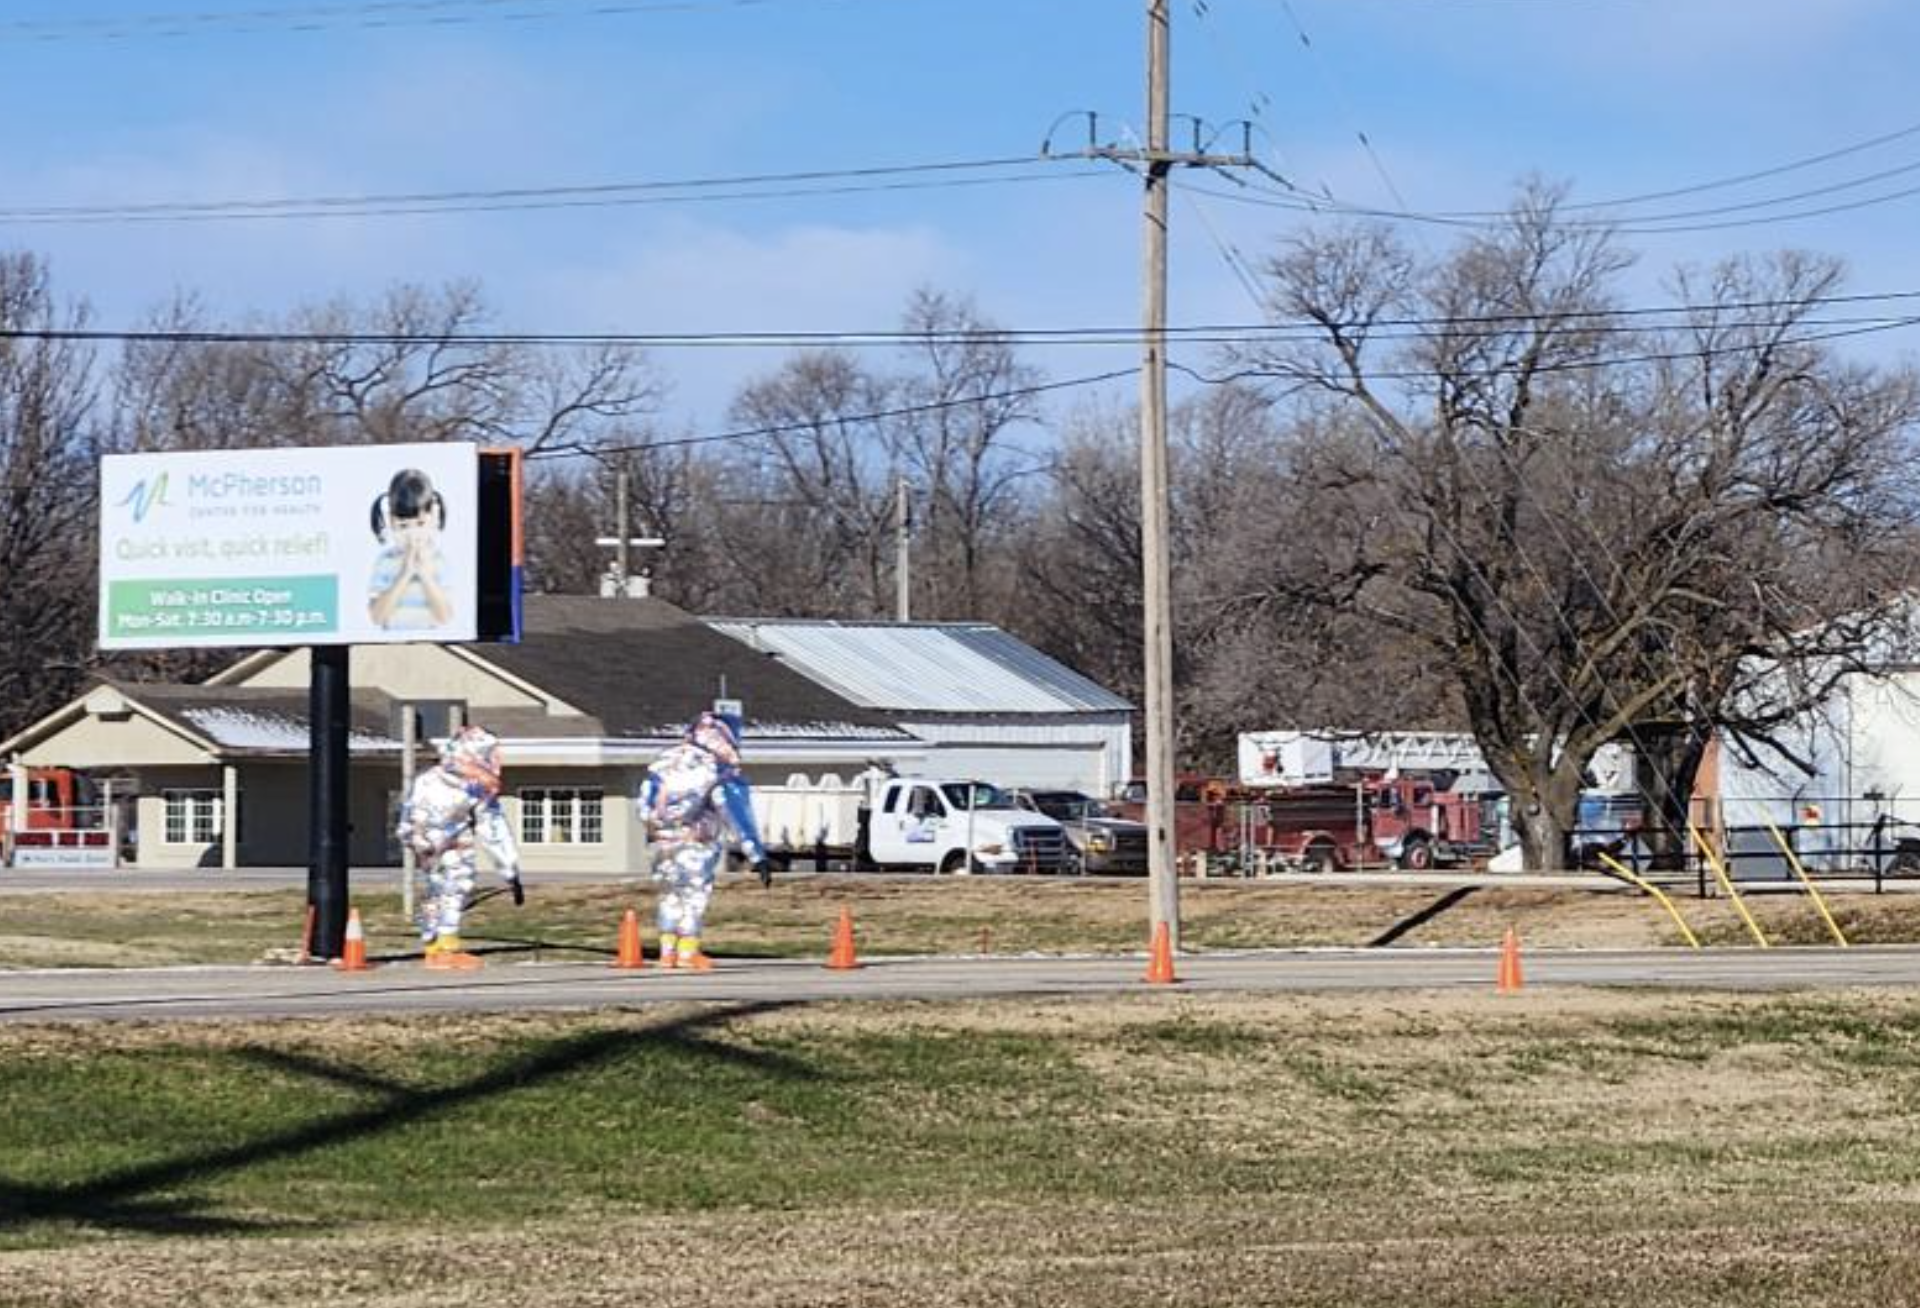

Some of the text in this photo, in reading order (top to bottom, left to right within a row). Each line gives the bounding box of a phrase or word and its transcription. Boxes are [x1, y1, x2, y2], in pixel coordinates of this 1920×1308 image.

[188, 472, 322, 497] McPherson
[242, 505, 267, 517] FOR
[116, 537, 168, 561] Quick
[219, 532, 269, 560] quick
[210, 590, 252, 605] Clinic
[253, 588, 294, 606] Open
